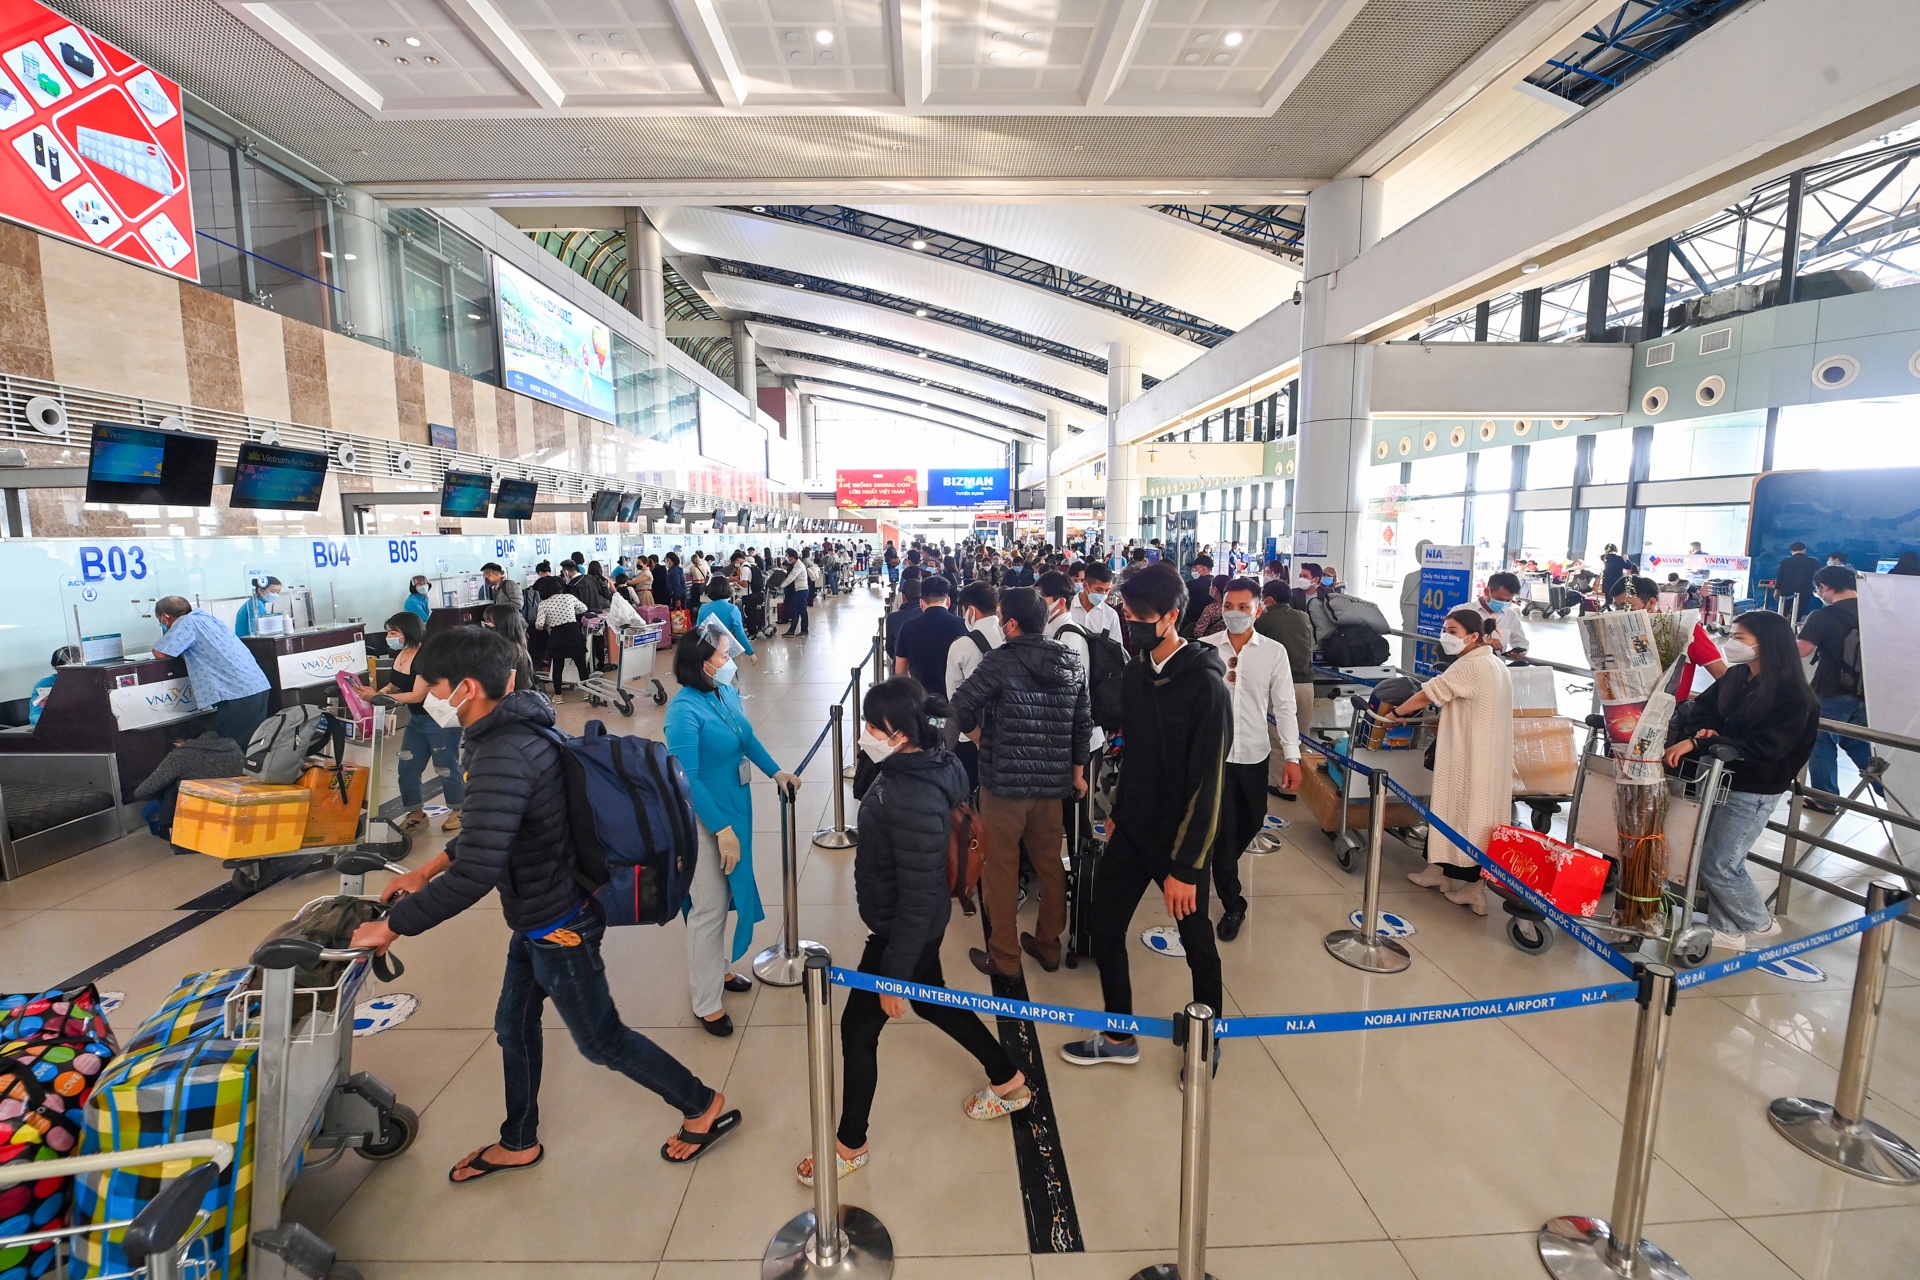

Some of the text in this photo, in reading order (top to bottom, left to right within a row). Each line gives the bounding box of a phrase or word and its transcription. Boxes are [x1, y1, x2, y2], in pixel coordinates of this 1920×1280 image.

[943, 476, 993, 488] BIZMAN
[388, 540, 418, 564] B05
[535, 538, 552, 556] B07
[595, 538, 608, 552] B08
[313, 541, 350, 568] B04
[1425, 549, 1443, 559] NIA
[80, 545, 147, 582] B03
[1423, 588, 1444, 610] 40
[1303, 737, 1340, 760] INTERNATIONAL AIRPORT
[1466, 845, 1480, 860] N.I.A
[1490, 864, 1507, 882] CẢNG
[1506, 875, 1525, 894] HÀNG
[1524, 891, 1548, 914] KHÔNG
[1548, 908, 1570, 929] QUỐC
[1570, 922, 1581, 937] TẾ
[1581, 930, 1596, 949] NỘI
[1596, 943, 1612, 960] BÀI
[1870, 912, 1886, 925] N.I.A
[1757, 922, 1860, 964] NOIBAI INTERNATIONAL AIRPORT
[1722, 960, 1742, 974] N.I.A
[829, 972, 846, 983] .I.A
[1692, 970, 1706, 984] BÀI
[875, 979, 1076, 1023] NOIBAI INTERNATIONAL AIRPORT
[1581, 990, 1609, 1003] N.I.A
[1364, 997, 1556, 1026] NOIBAI INTERNATIONAL AIRPORT
[1107, 1018, 1140, 1032] N.I.A
[1214, 1021, 1228, 1034] ÀI
[1286, 1020, 1317, 1032] N.I.A
[60, 1070, 83, 1096] LOVE
